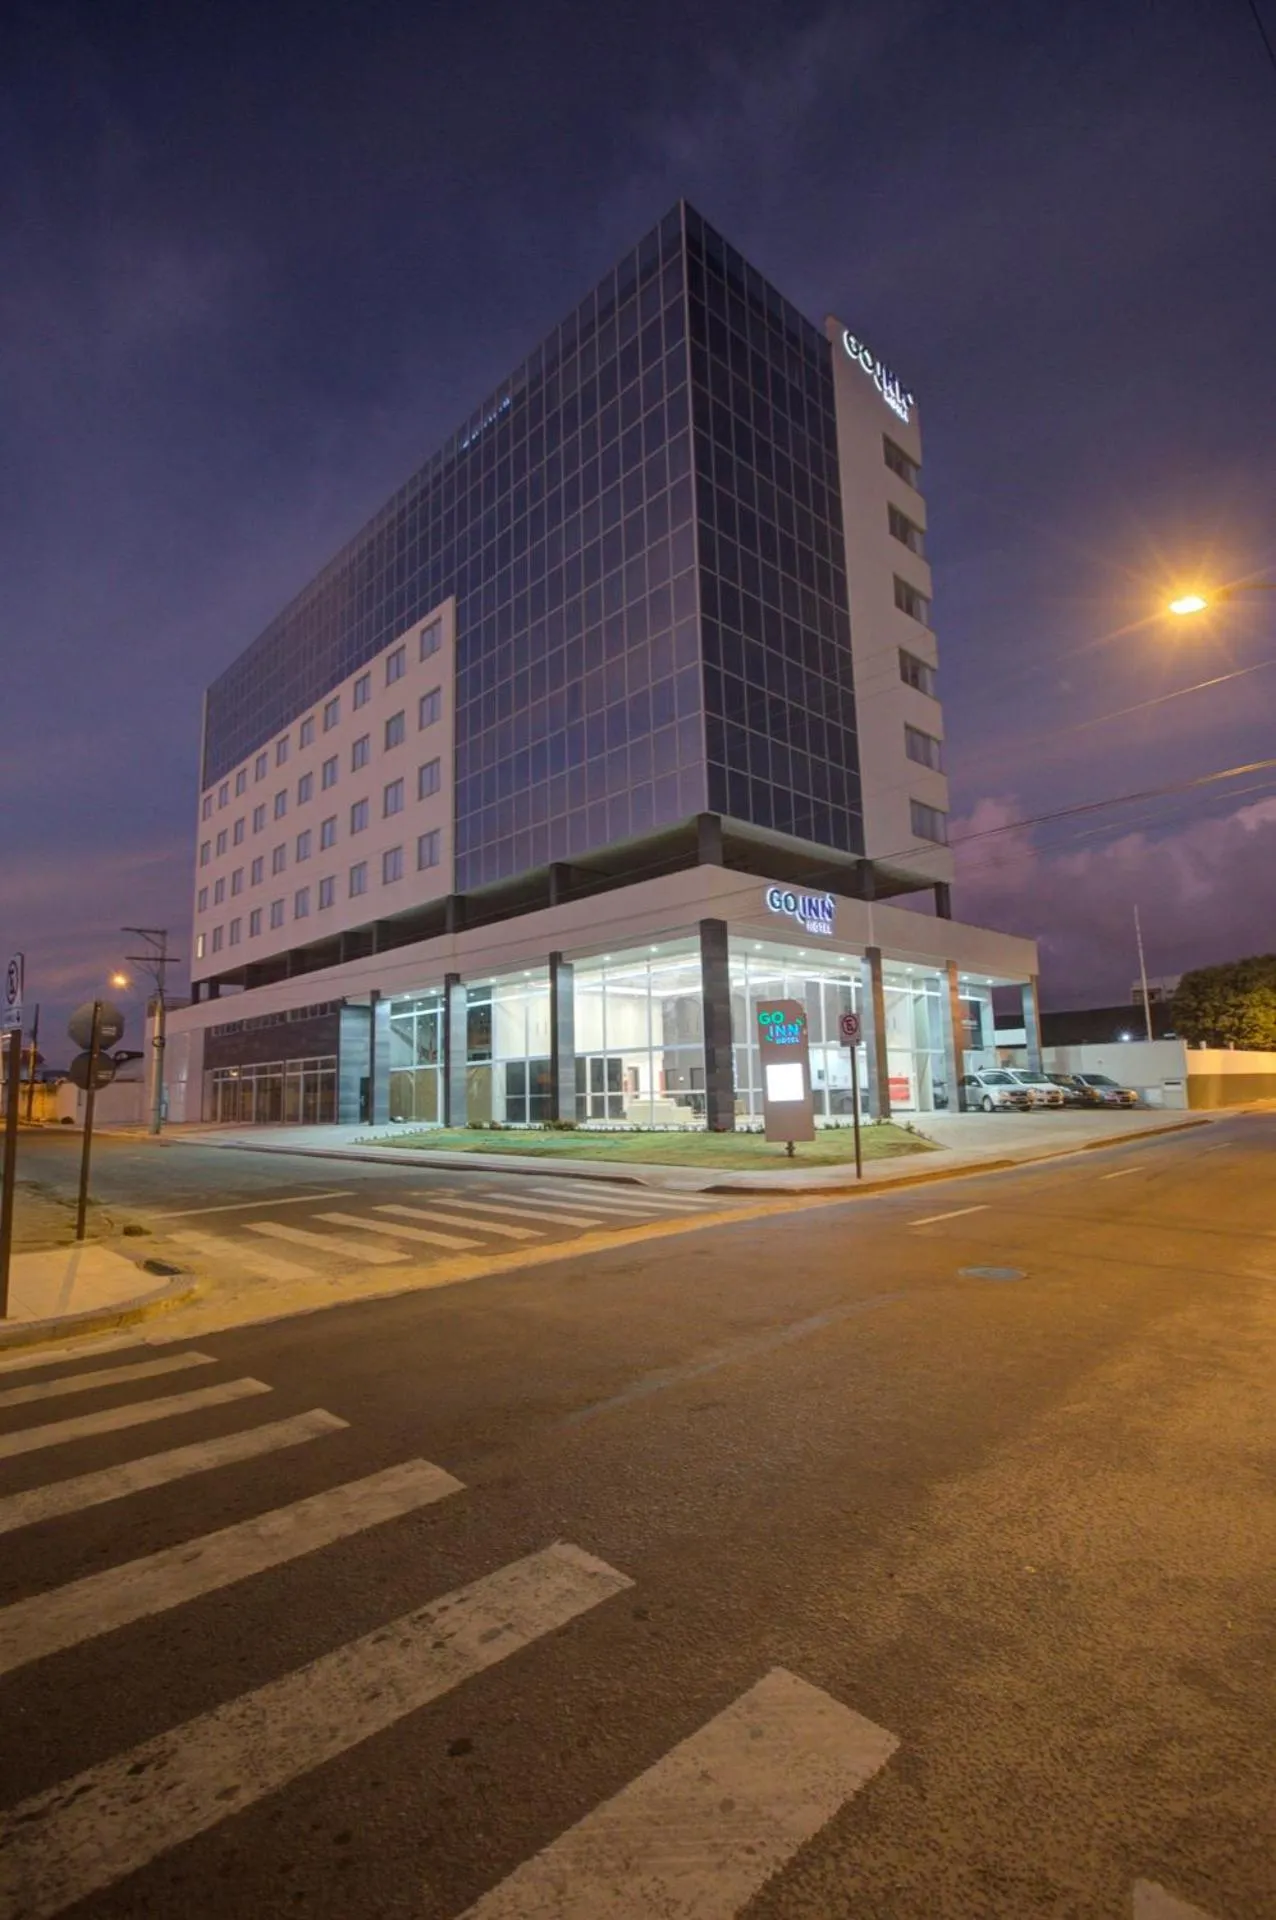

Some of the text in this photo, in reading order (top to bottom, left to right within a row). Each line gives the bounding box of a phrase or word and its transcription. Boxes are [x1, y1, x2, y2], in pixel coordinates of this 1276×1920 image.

[767, 888, 833, 921] GO INN
[759, 1010, 785, 1025] GO
[769, 1023, 799, 1037] INN
